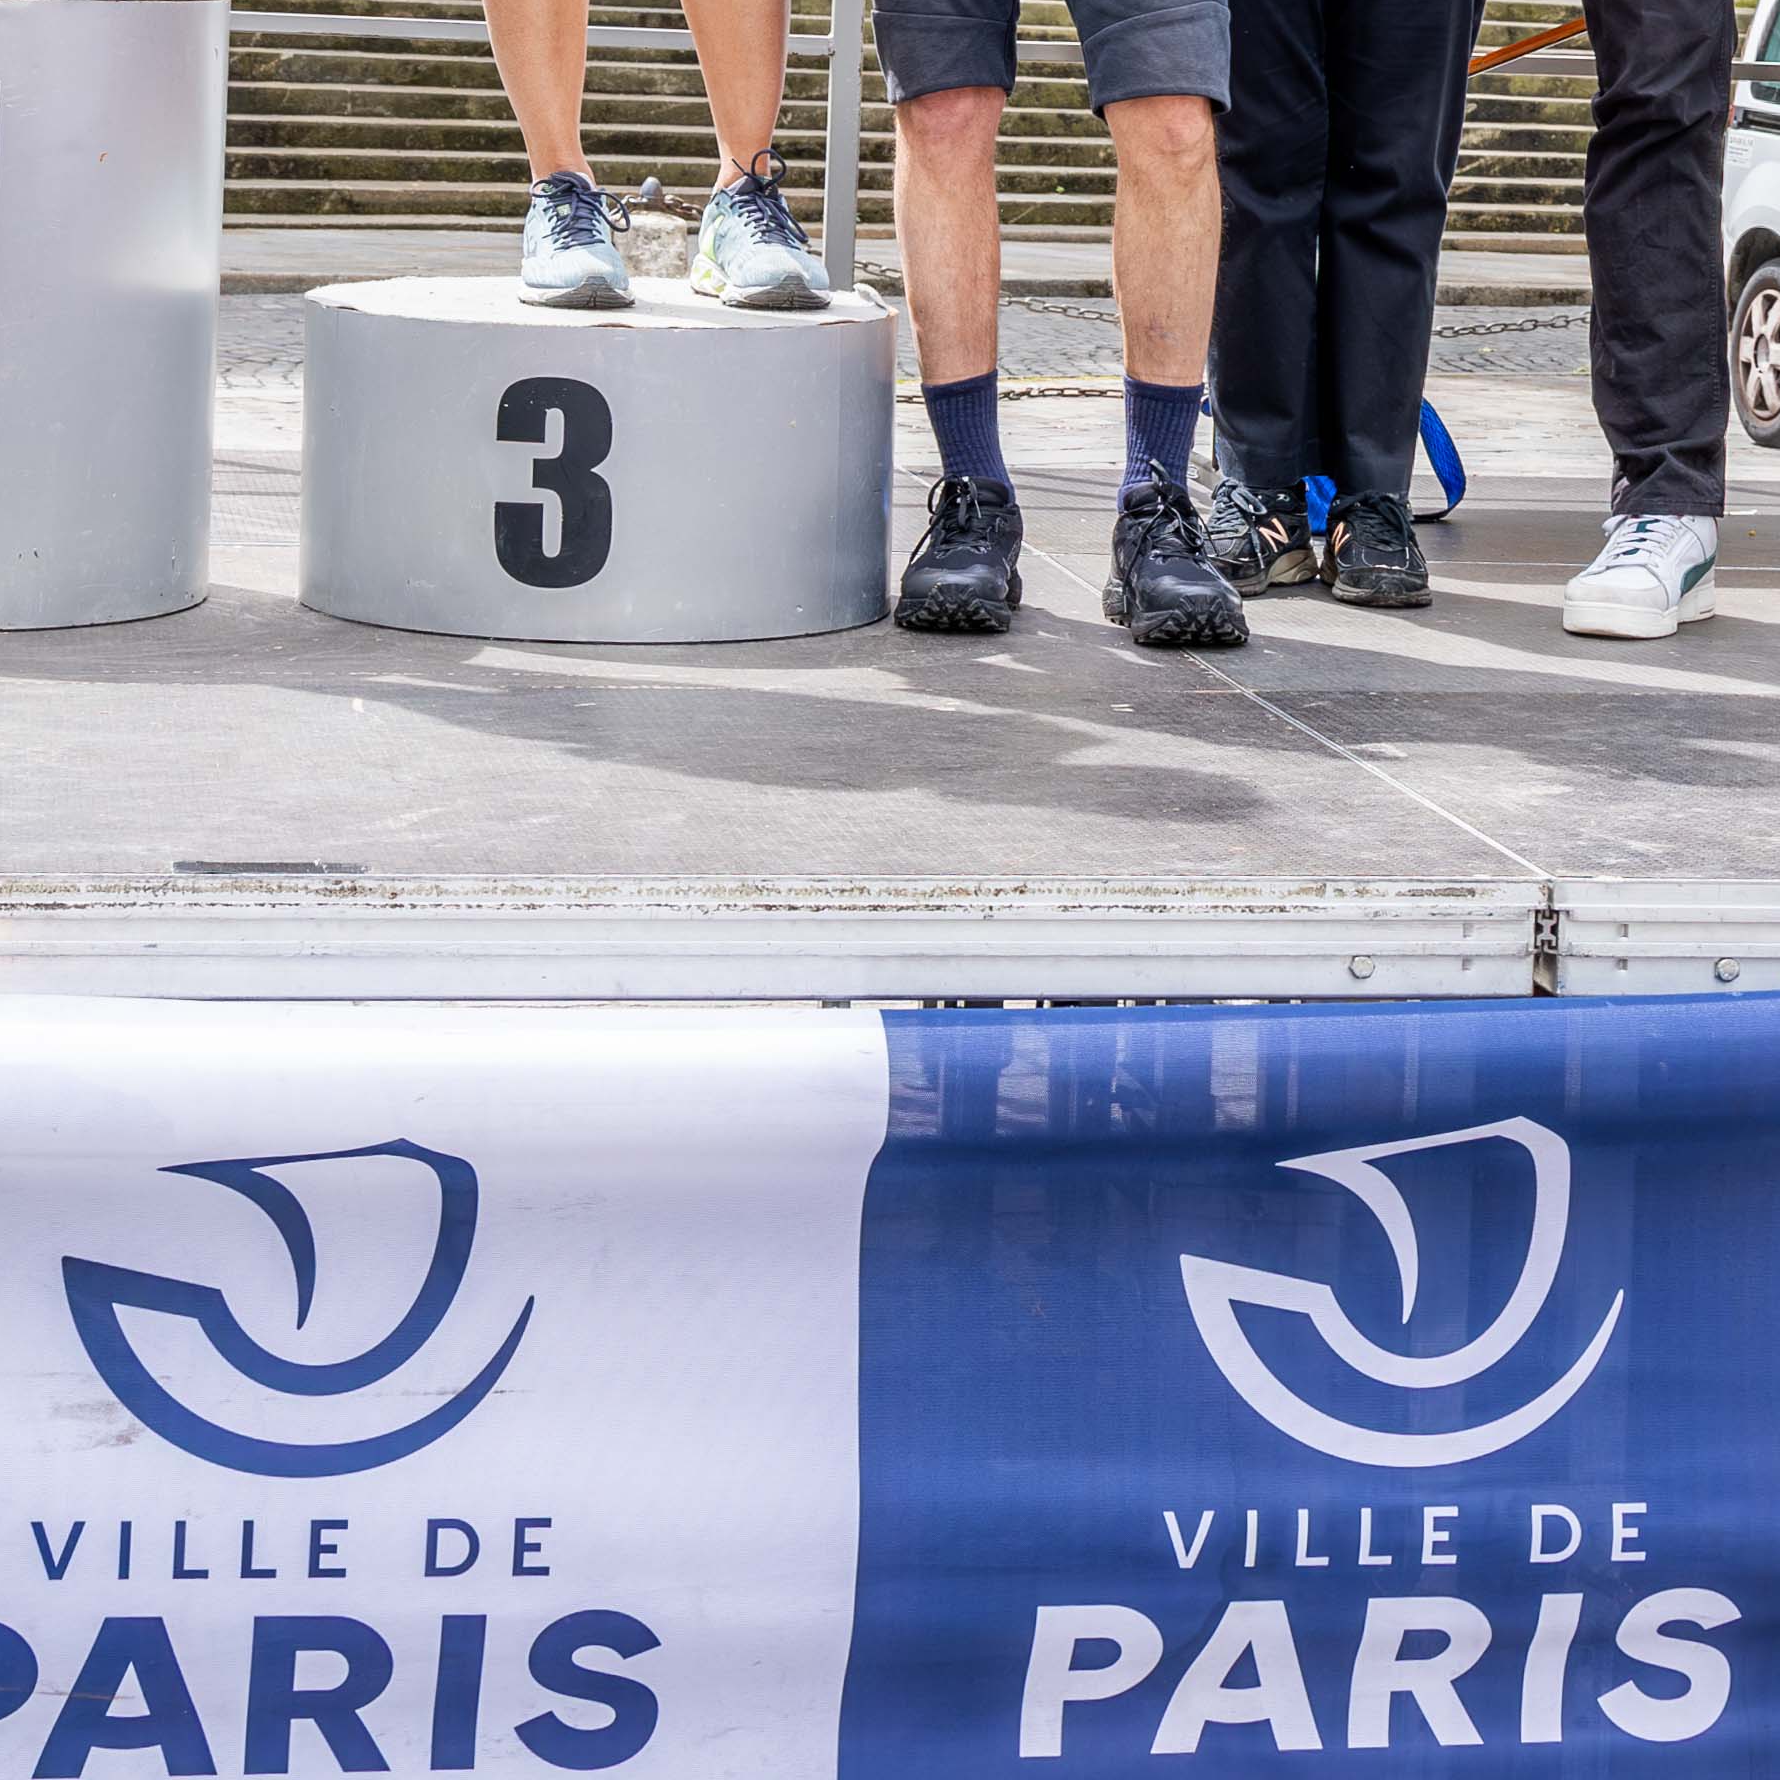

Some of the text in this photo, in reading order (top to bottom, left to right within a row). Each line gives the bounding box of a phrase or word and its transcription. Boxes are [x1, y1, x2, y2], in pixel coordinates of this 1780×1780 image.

[494, 377, 612, 588] 3
[30, 1517, 553, 1581] VILLE DE
[1163, 1502, 1647, 1569] VILLE DE
[1019, 1587, 1742, 1758] PARIS
